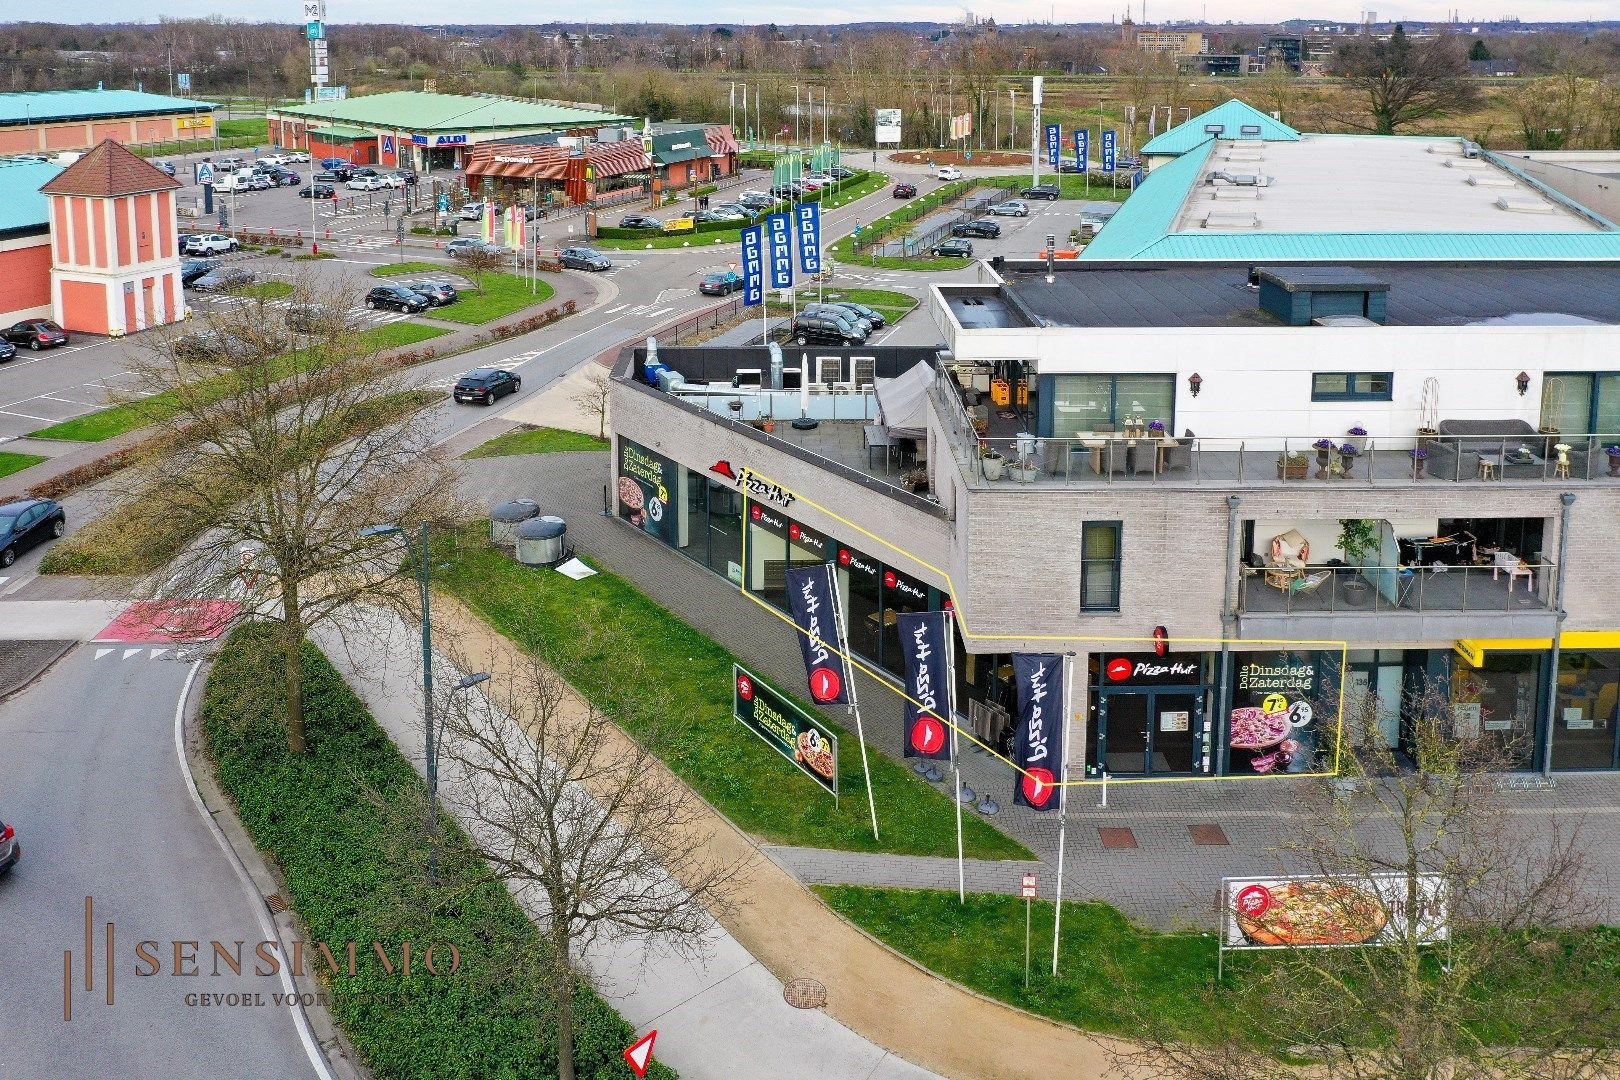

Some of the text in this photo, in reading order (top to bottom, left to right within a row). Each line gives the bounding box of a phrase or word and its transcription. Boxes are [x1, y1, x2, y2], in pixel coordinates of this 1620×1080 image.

[436, 135, 466, 145] ALDI
[767, 484, 796, 508] Hut
[850, 557, 877, 575] Pizza Hut
[896, 580, 926, 599] Pizza Hut
[1133, 662, 1169, 676] Pizza
[1239, 665, 1248, 690] Dolle
[1249, 677, 1312, 691] Zaterdag
